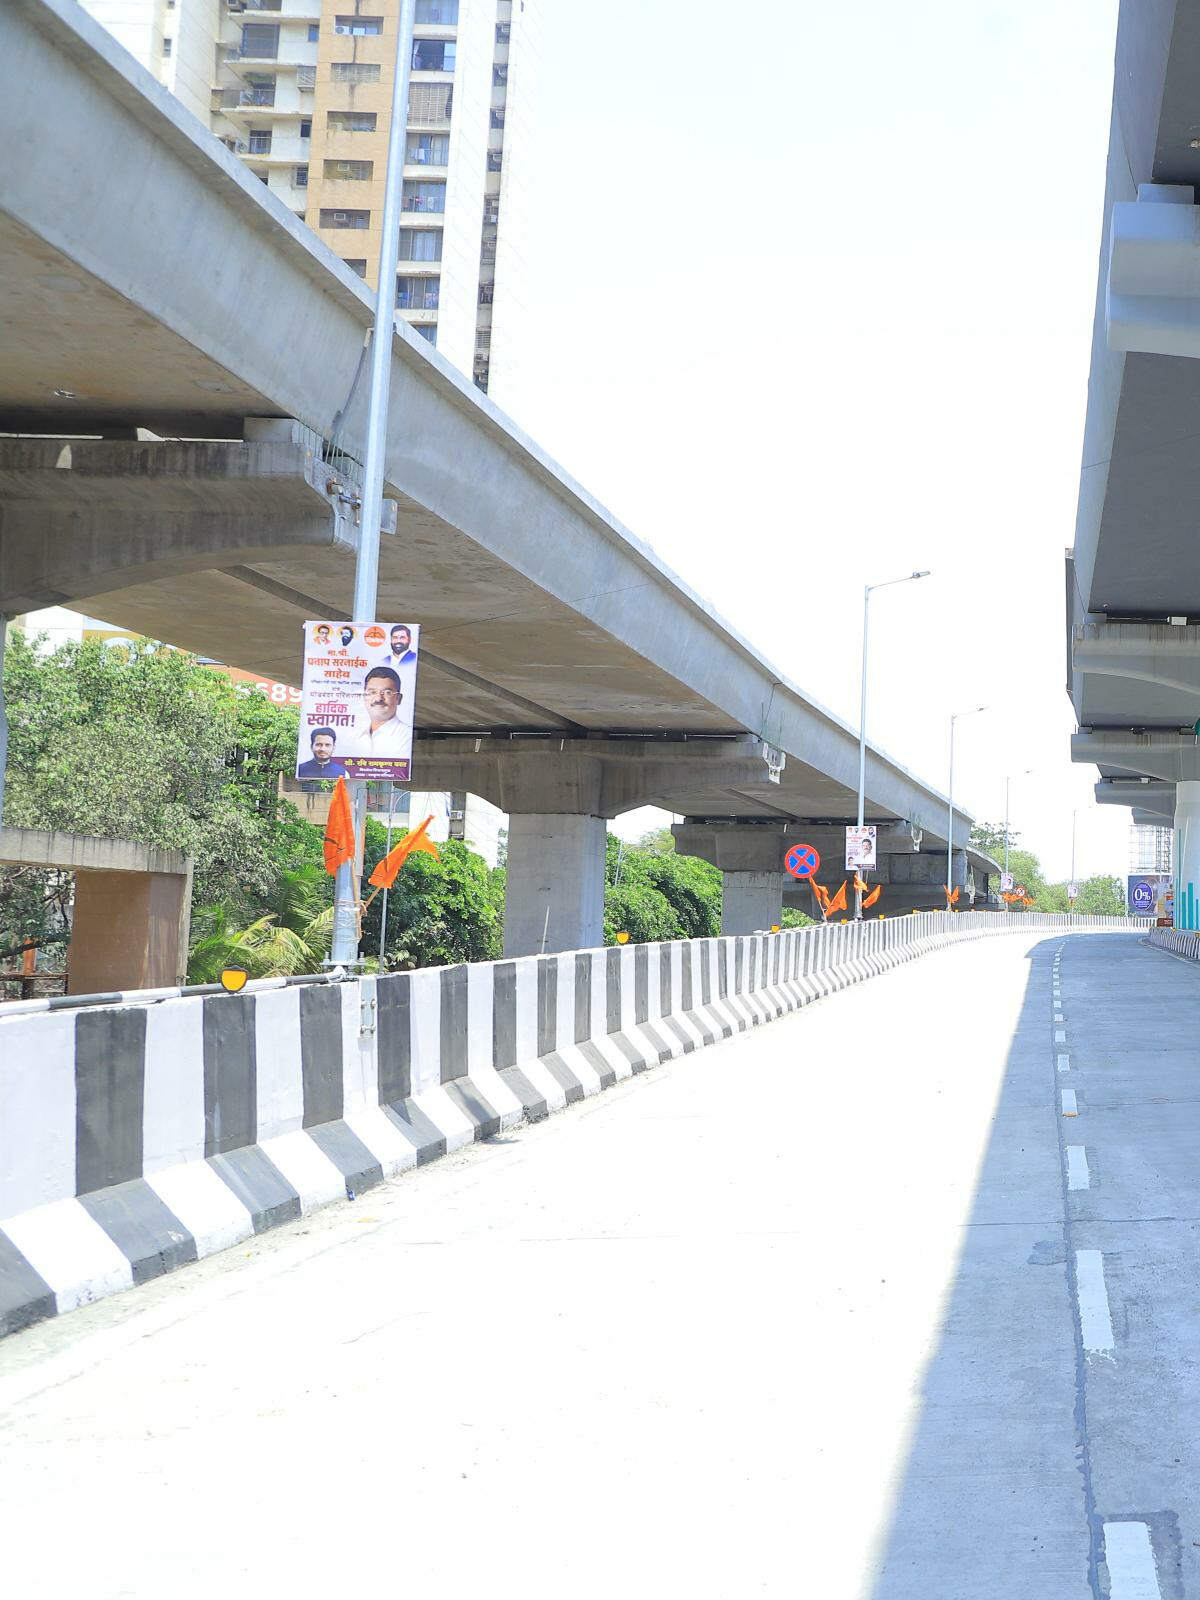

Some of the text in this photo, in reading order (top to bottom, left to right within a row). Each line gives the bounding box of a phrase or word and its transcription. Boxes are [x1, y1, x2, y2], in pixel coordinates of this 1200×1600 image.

[332, 656, 368, 668] सरनाईक
[324, 668, 350, 679] साहेब
[315, 699, 348, 714] हार्दिक
[306, 713, 355, 727] स्वागत!
[1134, 888, 1151, 901] 0%
